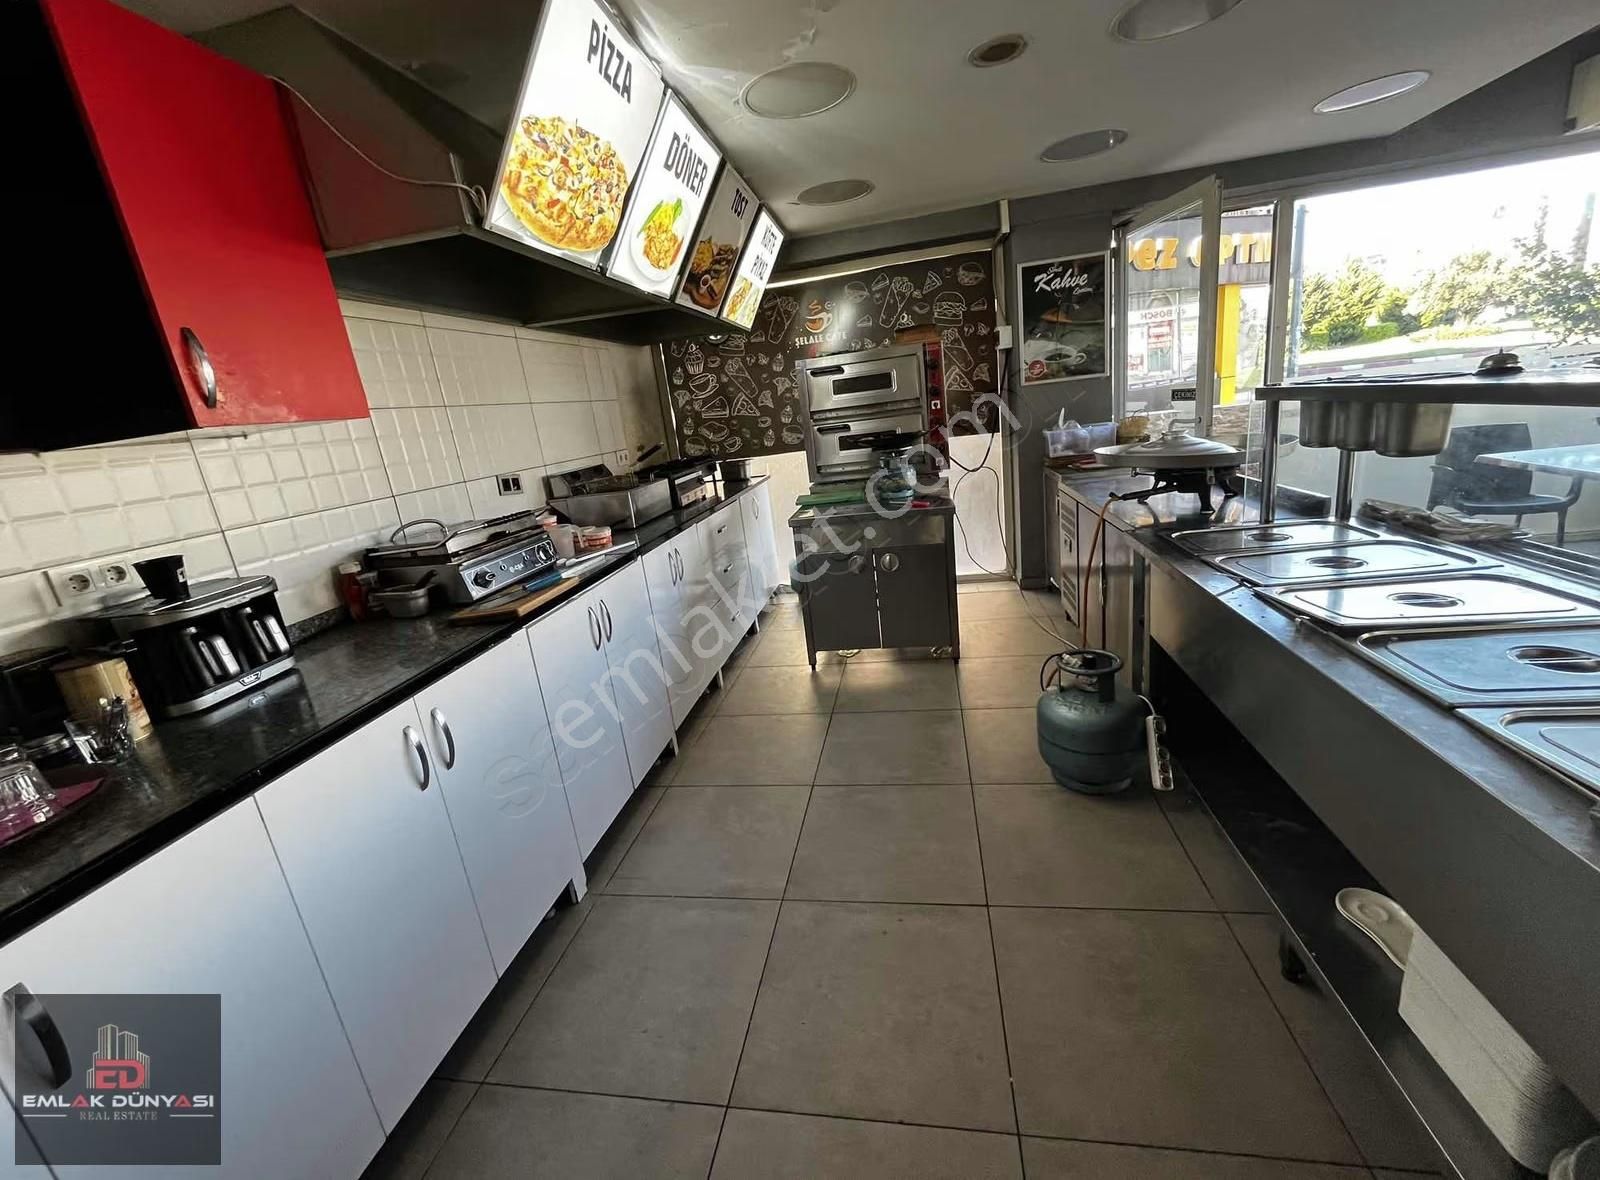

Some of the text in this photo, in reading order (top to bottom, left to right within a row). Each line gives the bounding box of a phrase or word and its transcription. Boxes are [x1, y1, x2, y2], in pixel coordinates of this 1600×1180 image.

[587, 18, 633, 105] PİZZA
[663, 132, 709, 198] DÖNER
[730, 187, 749, 220] TOST
[1033, 267, 1089, 293] Kahve
